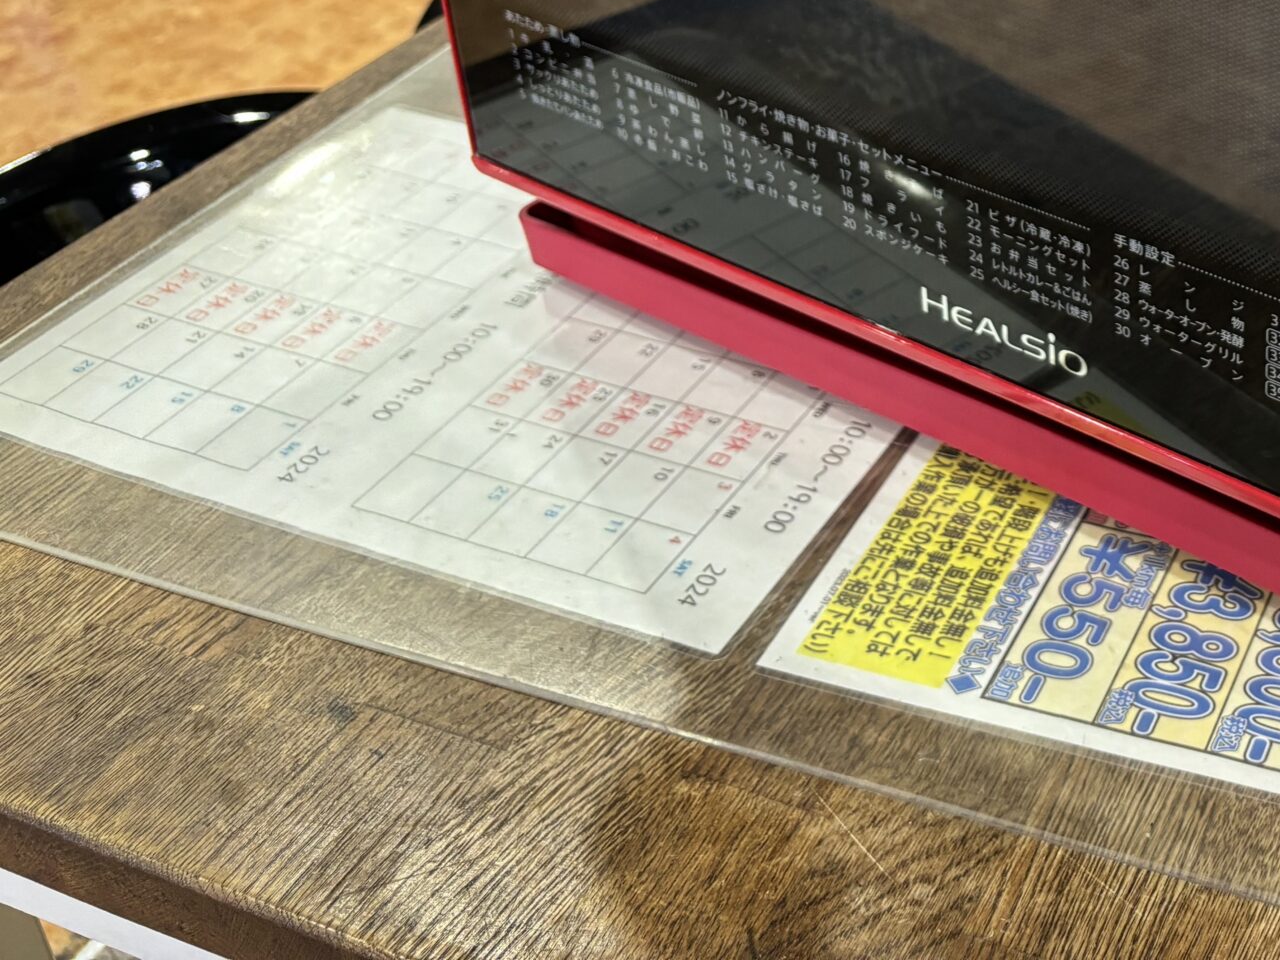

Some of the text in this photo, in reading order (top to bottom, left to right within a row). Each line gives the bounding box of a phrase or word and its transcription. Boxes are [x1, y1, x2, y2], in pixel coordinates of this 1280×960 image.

[718, 107, 728, 119] 11
[721, 124, 818, 169] 12 チキンステーキ
[723, 139, 819, 185] 13 ハンバーグ
[724, 155, 821, 200] 14 グラタン
[726, 170, 738, 184] 15
[838, 151, 943, 200] 16 焼きば
[840, 168, 944, 216] 17 フライ
[841, 184, 946, 235] 18 焼きいも
[843, 200, 947, 249] 19 ドライフード
[966, 199, 980, 214] 21
[843, 216, 948, 265] 20 スポンジケーキ
[967, 216, 1091, 271] 22 モーニングセット
[969, 249, 983, 264] 24
[1113, 233, 1176, 268] 手動設定
[968, 233, 1091, 288] 23 お弁当セット
[970, 266, 984, 281] 25
[136, 269, 199, 306] 定休日
[1113, 254, 1245, 311] 26 レンジ
[1114, 288, 1130, 304] 28
[1114, 271, 1245, 332] 27 蒸し物
[186, 283, 246, 322] 定休日
[136, 317, 157, 329] 28
[186, 331, 206, 343] 21
[1114, 305, 1243, 365] 29 ウォーターグリル
[73, 360, 94, 372] 29
[234, 347, 254, 358] 14
[1115, 322, 1243, 381] 30 オーブン
[120, 376, 143, 389] 22
[171, 392, 192, 403] 15
[486, 362, 549, 406] 定休日
[543, 377, 601, 421] 定休日
[489, 420, 508, 432] 31
[595, 389, 653, 436] 定休日
[646, 404, 665, 415] 16
[649, 403, 707, 451] 定休日
[544, 435, 562, 448] 24
[600, 452, 617, 465] 17
[707, 419, 767, 467] 定休日
[278, 446, 330, 482] 2024
[654, 468, 674, 481] 10
[488, 486, 508, 500] 25
[718, 482, 732, 490] 3
[544, 504, 564, 517] 18
[605, 521, 624, 533] 11
[844, 453, 985, 639] 承頂いた上での作業となります。
[674, 561, 692, 576] SAT
[678, 564, 726, 606] 2024
[1018, 532, 1138, 704] ¥550-
[992, 661, 1026, 702] 追加
[1098, 687, 1141, 728] 税込
[1212, 713, 1254, 756] 税込
